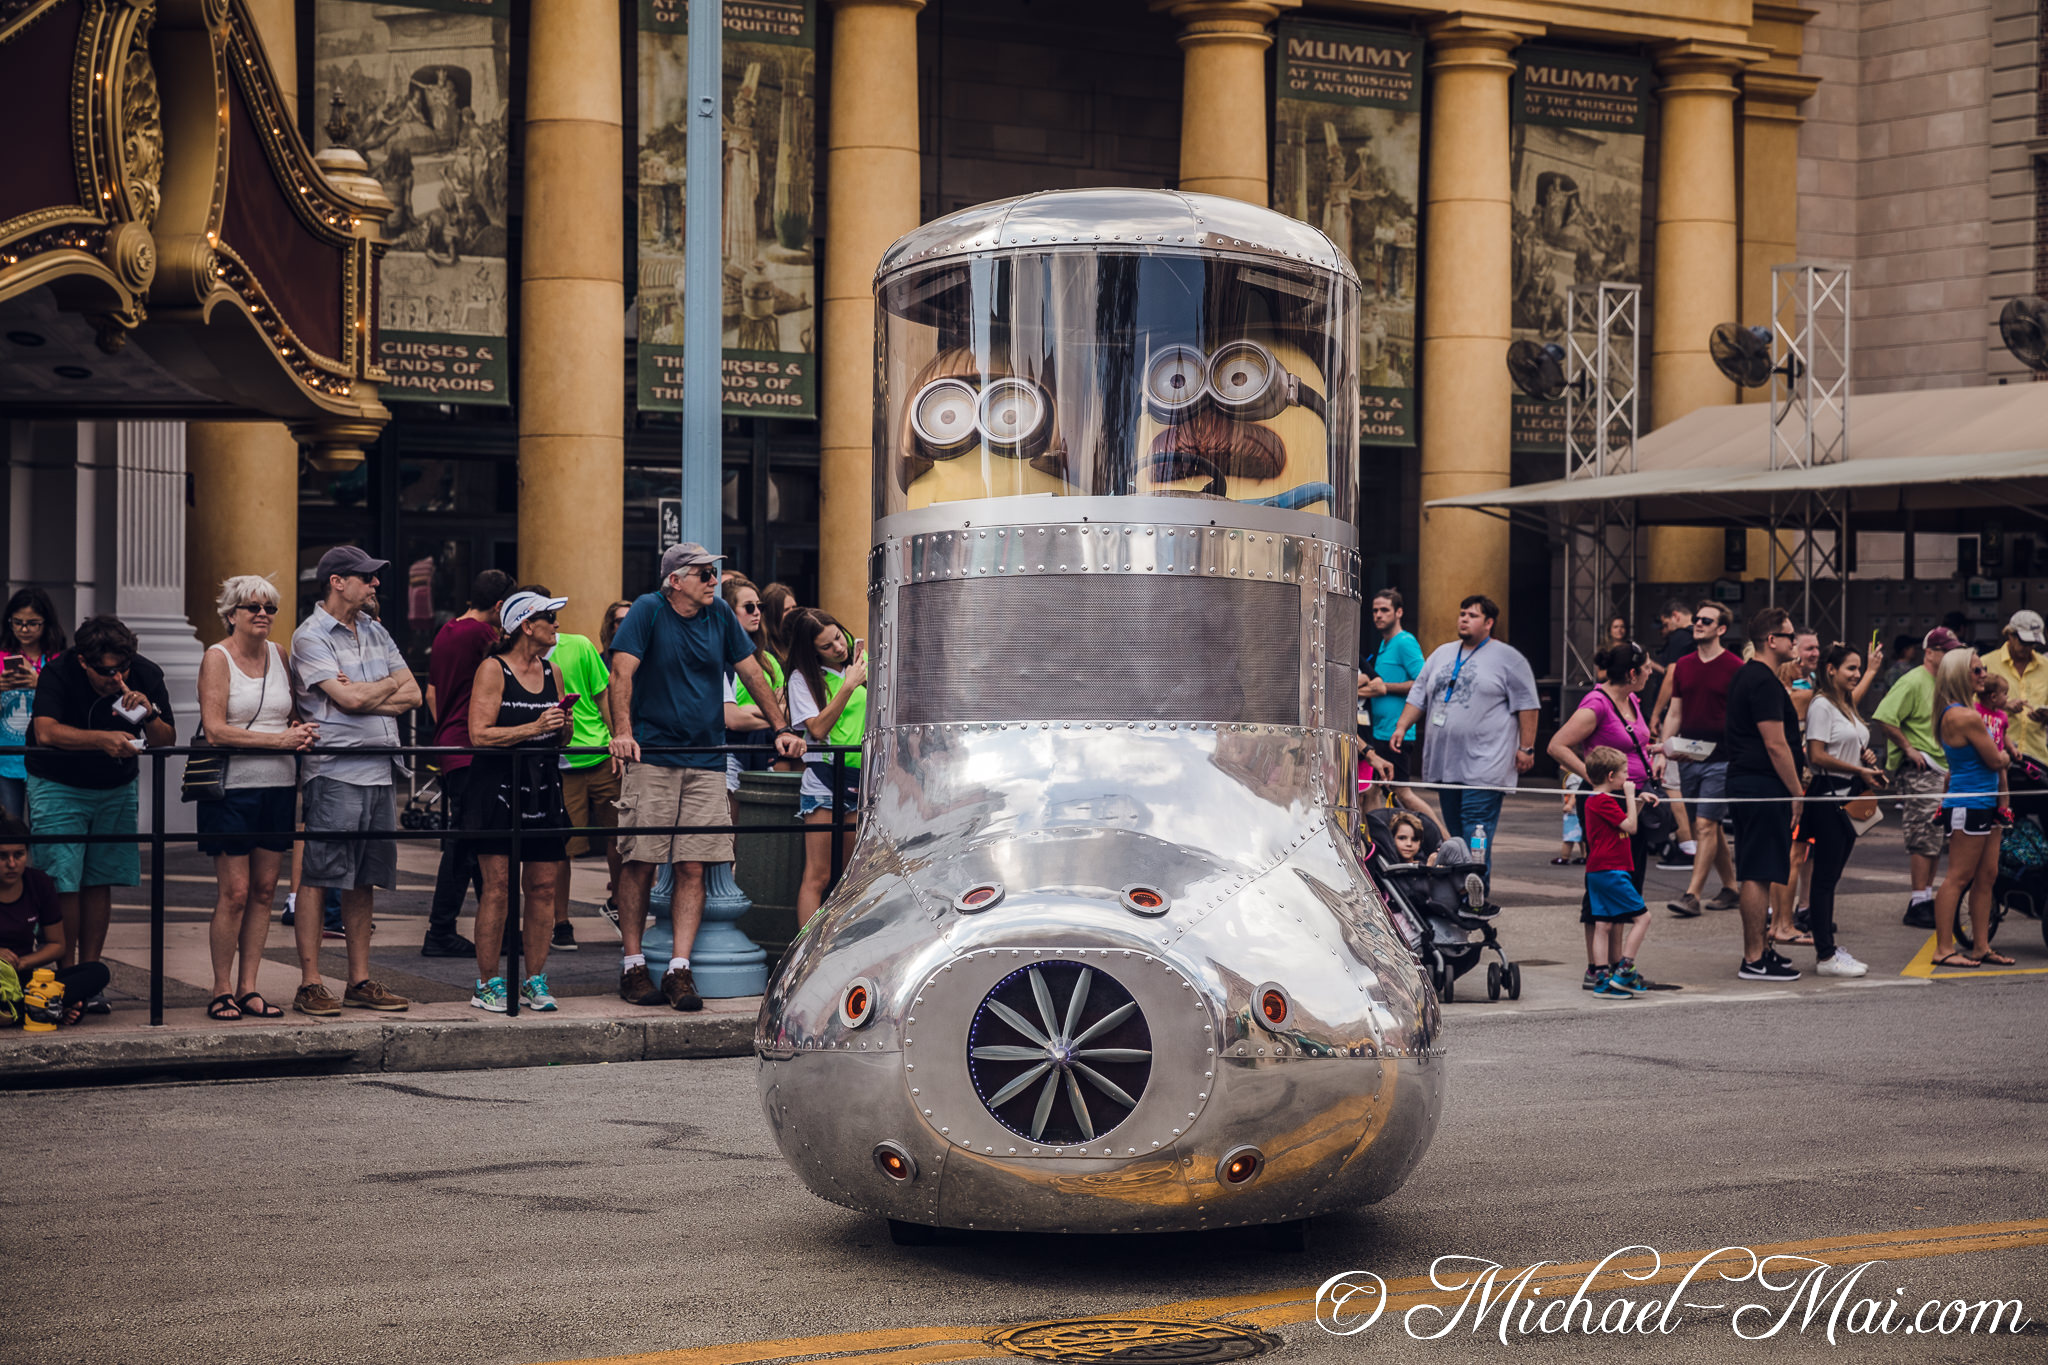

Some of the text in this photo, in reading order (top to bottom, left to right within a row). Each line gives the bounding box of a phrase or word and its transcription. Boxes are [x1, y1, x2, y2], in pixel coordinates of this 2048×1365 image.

[656, 11, 680, 23] OF
[723, 5, 804, 24] MUSEUM
[1288, 38, 1413, 68] MUMMY
[1288, 67, 1413, 90] AT THE MUSEUM
[1525, 65, 1639, 92] MUMMY
[1290, 79, 1409, 101] OF ANTIQUITIES
[1525, 93, 1638, 114] AT THE MUSEUM
[1525, 105, 1635, 124] OF ANTIQUITIES
[380, 341, 493, 360] CURSES &
[379, 358, 482, 375] ENDS OF
[722, 359, 780, 375] RSES
[785, 362, 802, 376] &
[391, 375, 495, 393] HARAOHS
[765, 377, 792, 390] OF
[722, 390, 803, 408] ARAOHS
[1389, 397, 1404, 409] &
[1373, 409, 1396, 421] OF
[1514, 404, 1544, 415] THE
[1512, 431, 1544, 443] THE
